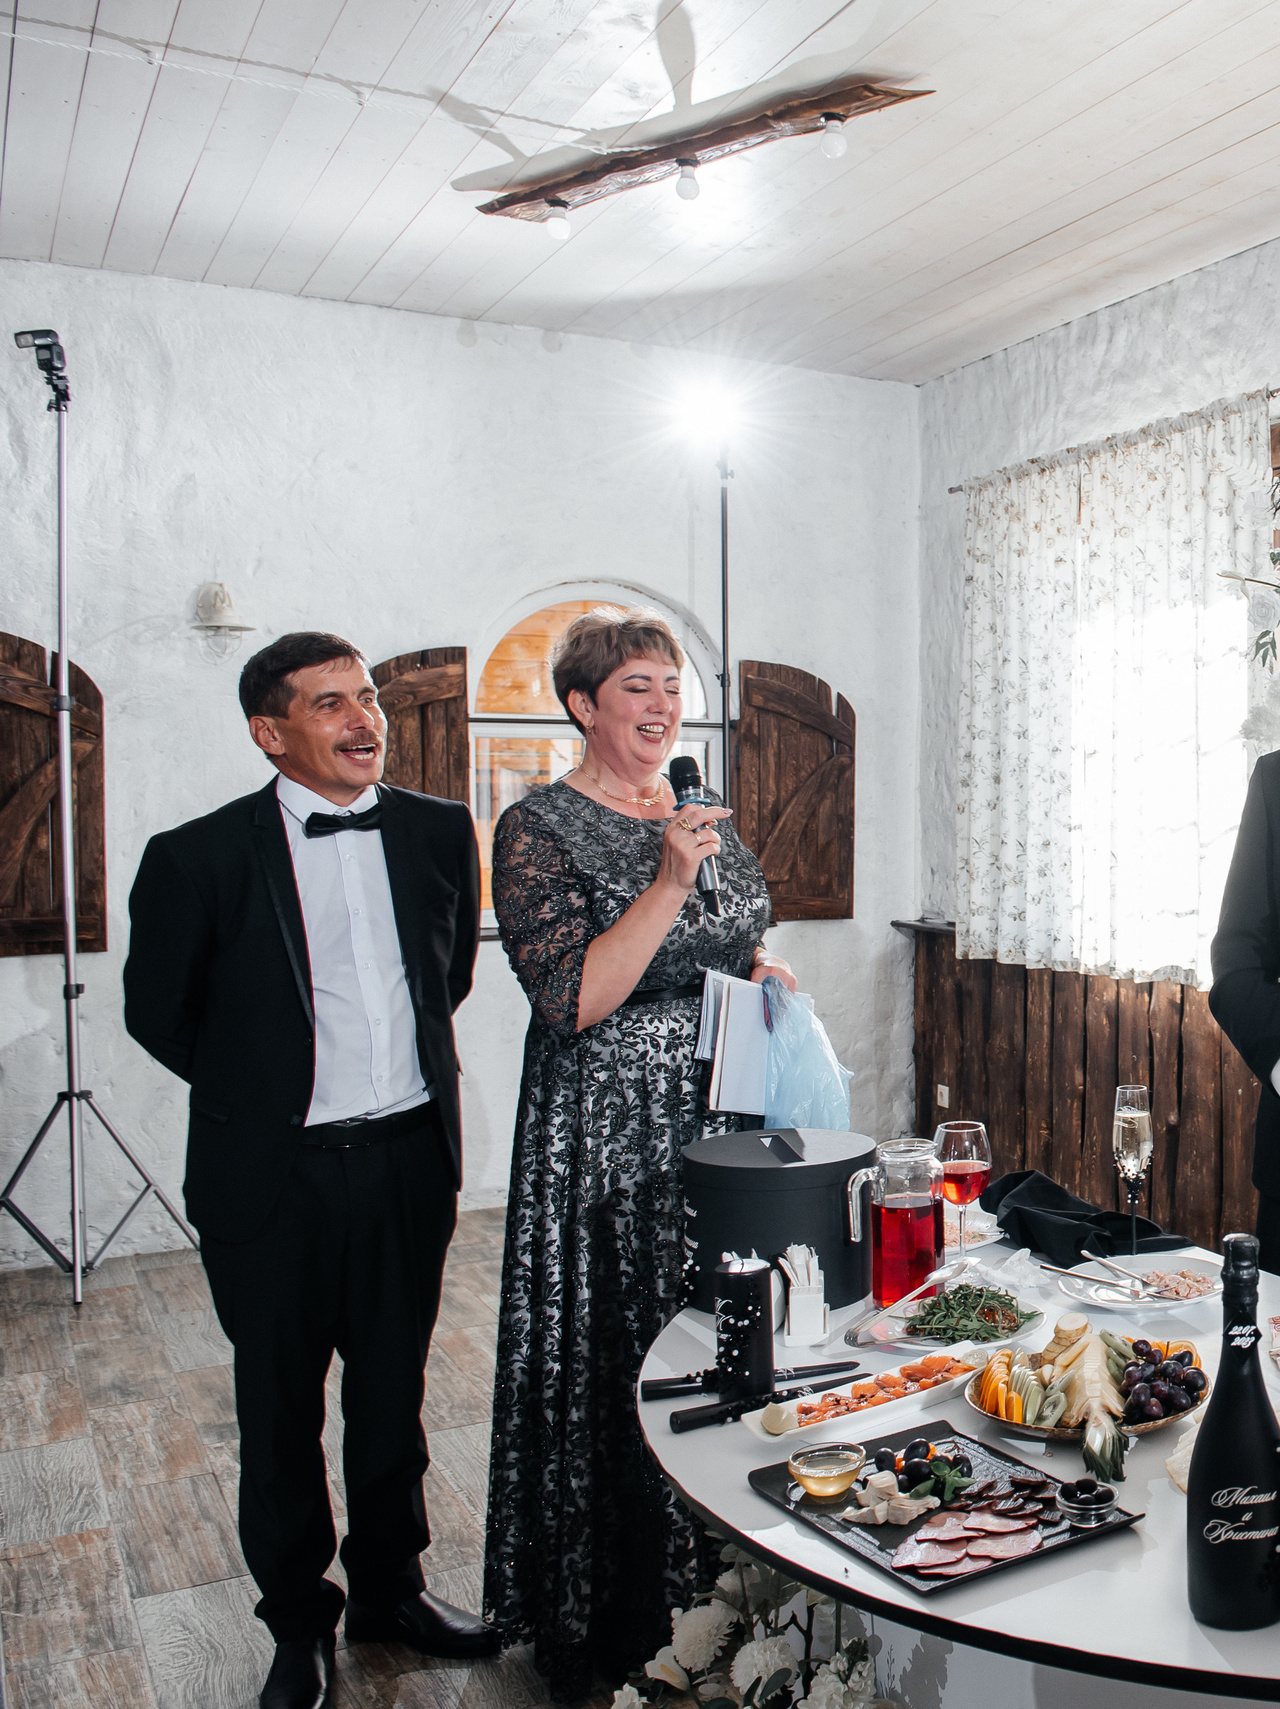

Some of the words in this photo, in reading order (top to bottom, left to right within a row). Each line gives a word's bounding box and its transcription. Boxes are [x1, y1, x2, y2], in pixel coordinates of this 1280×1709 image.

[1230, 1336, 1256, 1349] 2023
[1210, 1486, 1278, 1508] Михаил
[1203, 1519, 1280, 1544] Кристина
